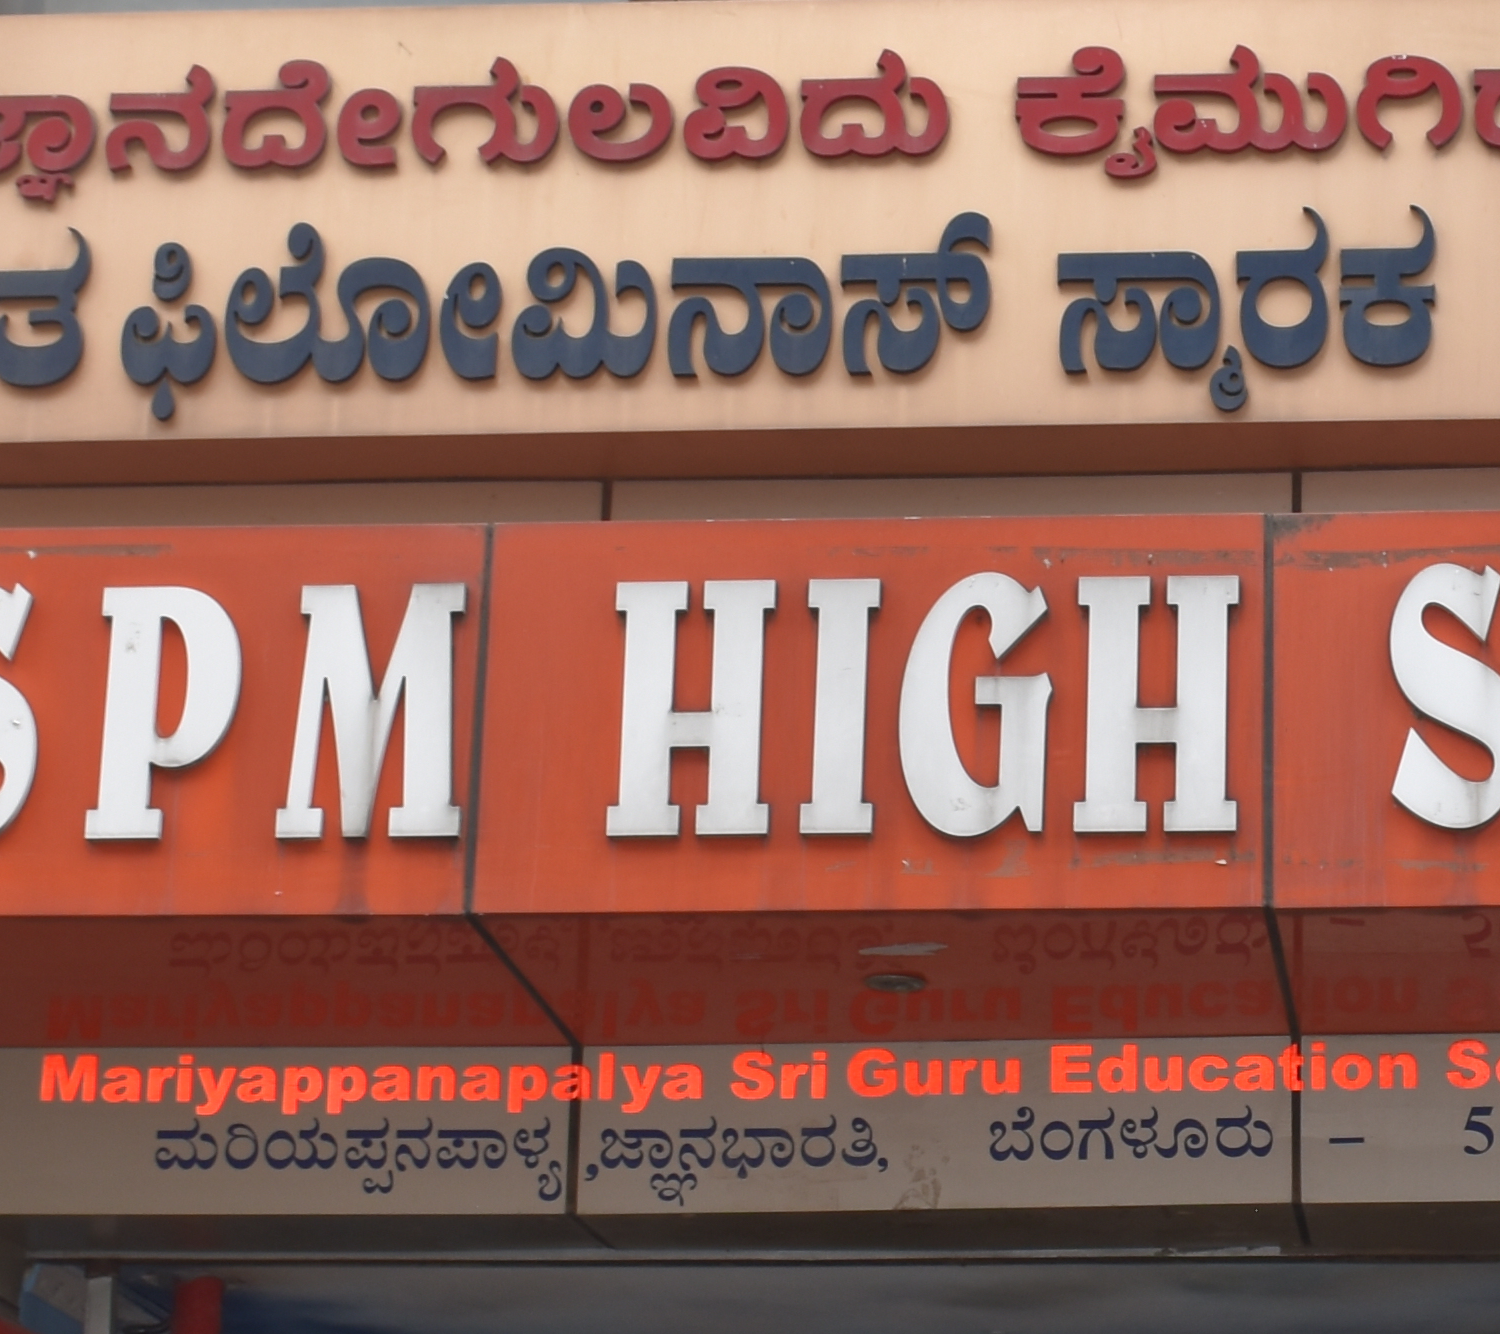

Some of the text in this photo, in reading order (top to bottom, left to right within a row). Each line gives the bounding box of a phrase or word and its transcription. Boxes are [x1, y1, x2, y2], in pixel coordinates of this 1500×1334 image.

[1056, 202, 1438, 412] ಸ್ಮಾರಕ
[605, 570, 1241, 839] HIGH
[39, 1051, 704, 1115] Mariyappanapalya
[729, 1048, 828, 1100] Sri
[847, 1046, 1021, 1097] Guru
[1049, 1039, 1418, 1095] Education
[989, 1105, 1274, 1162] ಬೆಂಗಳೂರು
